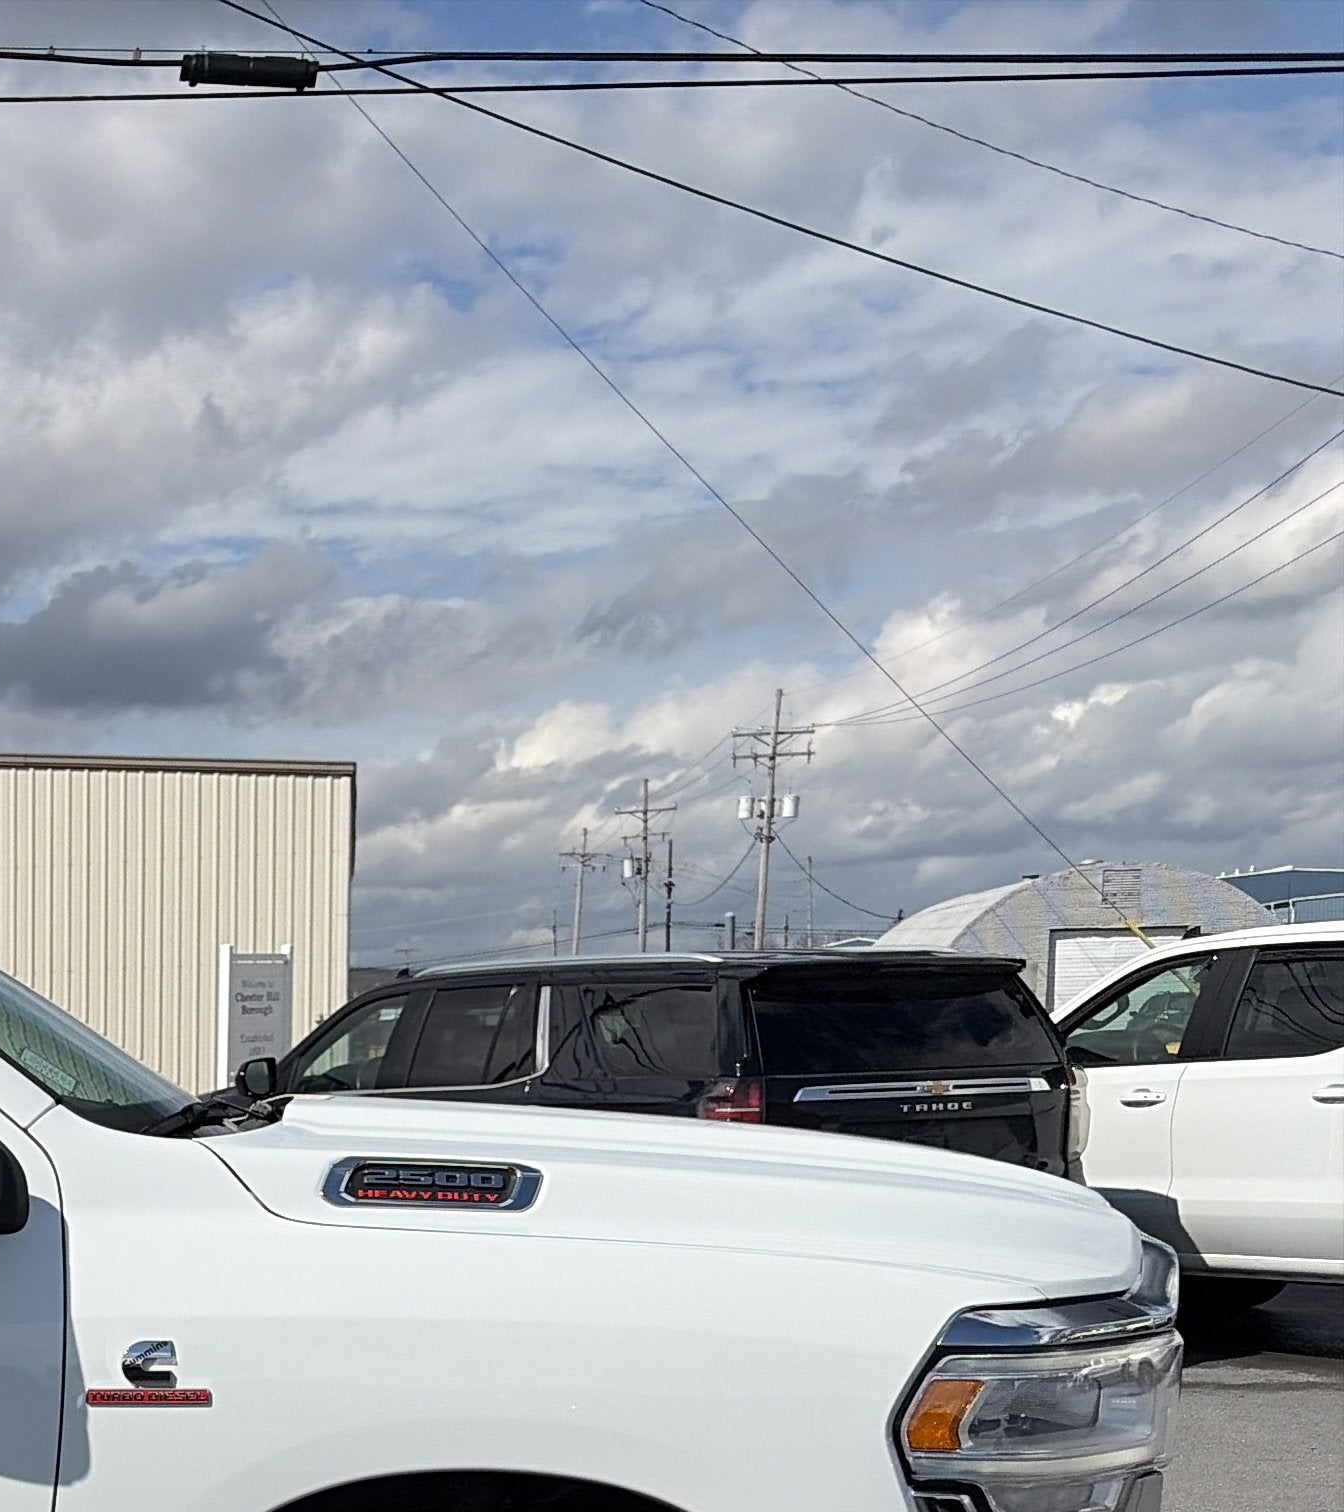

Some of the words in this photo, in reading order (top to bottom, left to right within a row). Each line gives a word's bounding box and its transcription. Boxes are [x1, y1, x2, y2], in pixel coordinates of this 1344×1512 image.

[899, 1101, 974, 1113] TAHOE
[362, 1168, 505, 1189] 2500
[357, 1188, 433, 1200] HEAVY
[437, 1190, 500, 1202] DUTY
